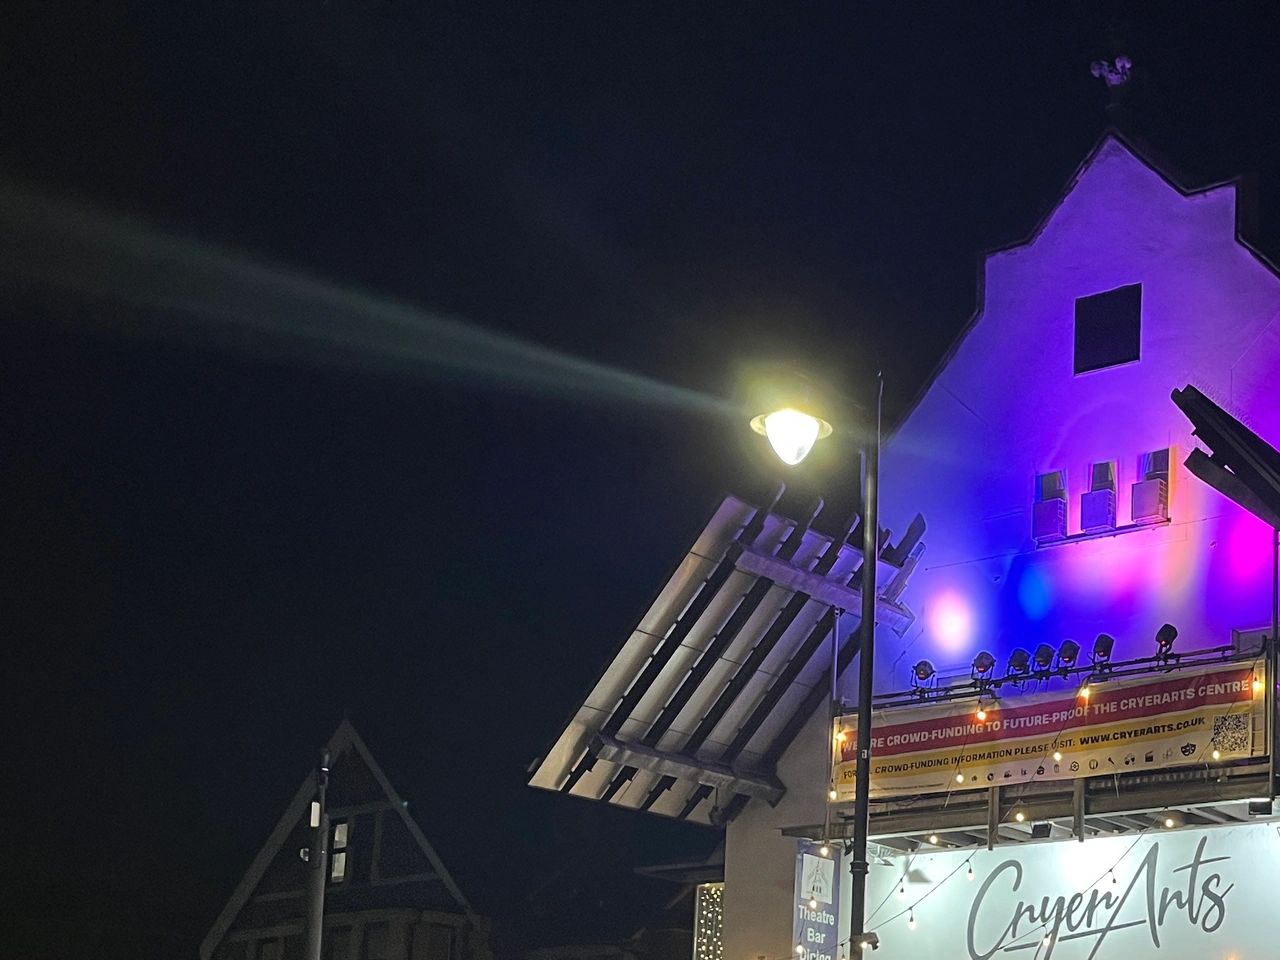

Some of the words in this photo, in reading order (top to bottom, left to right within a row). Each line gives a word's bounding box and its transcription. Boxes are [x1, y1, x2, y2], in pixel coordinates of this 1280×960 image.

[887, 723, 984, 747] CROWD-FUNDING
[986, 721, 1001, 732] TO
[1003, 705, 1090, 729] FUTURE-PROOF
[1094, 701, 1117, 715] THE
[1120, 688, 1195, 711] CRYERARTS
[1198, 679, 1250, 697] CENTRE
[875, 758, 949, 774] CROWD-FUNDING
[951, 749, 1012, 764] INFORMATION
[1015, 743, 1049, 755] PLEASE
[1079, 717, 1206, 745] WWW.CRYERARTS.CO.UK
[798, 905, 835, 926] Theatre
[807, 927, 826, 944] Bar
